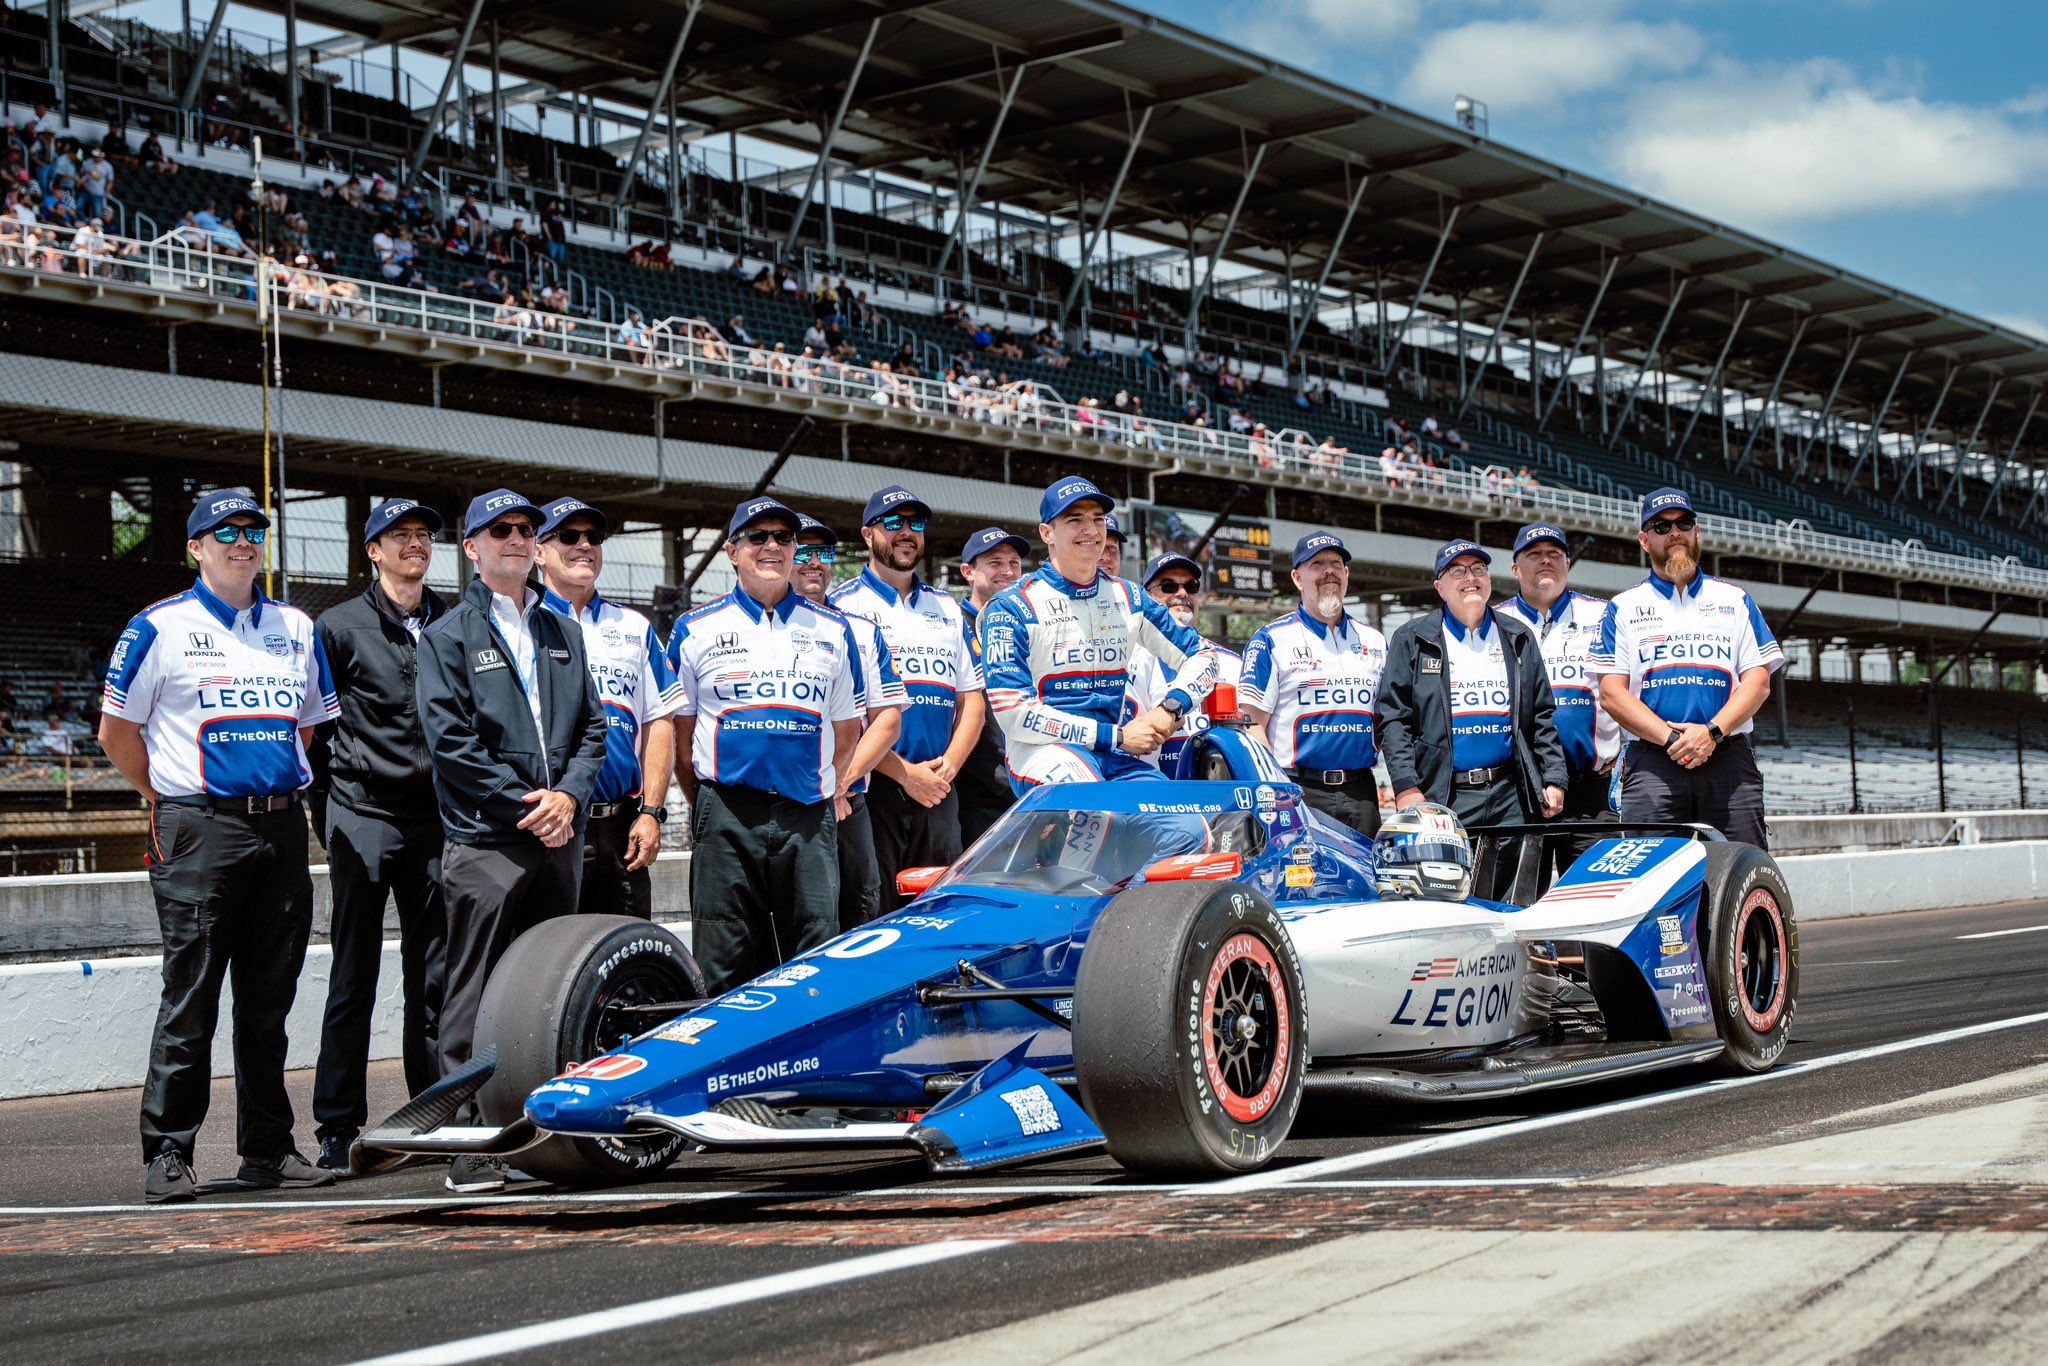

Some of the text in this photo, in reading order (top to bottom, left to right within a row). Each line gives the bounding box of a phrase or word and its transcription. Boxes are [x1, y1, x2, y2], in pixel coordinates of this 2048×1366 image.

[688, 598, 727, 617] Firestone
[803, 599, 841, 619] Firestone
[986, 614, 1019, 626] LEGION
[1044, 615, 1080, 627] HONDA
[1629, 617, 1664, 625] HONDA
[999, 629, 1014, 641] THE
[1078, 637, 1128, 646] AMERICAN
[1665, 633, 1731, 643] AMERICAN
[184, 650, 227, 658] HONDA
[707, 647, 750, 657] HONDA
[898, 646, 958, 660] AMERICAN
[986, 642, 1016, 665] ONE
[1052, 647, 1128, 667] LEGION
[1638, 643, 1731, 664] LEGION
[474, 661, 507, 673] HONDA
[590, 663, 639, 683] ERICAN
[893, 657, 957, 678] EGION
[750, 669, 829, 682] AMERICAN
[1642, 676, 1727, 689] BETHEONE.ORG
[232, 676, 306, 690] AMERICAN
[597, 675, 636, 699] ION
[1457, 680, 1508, 689] AMERIC
[713, 681, 828, 703] LEGION
[1297, 688, 1376, 706] LEGIO
[1450, 690, 1509, 707] EGIO
[197, 688, 306, 711] LEGION
[909, 695, 955, 708] EONE.ORG
[1022, 710, 1089, 745] BE THE ONE
[1302, 723, 1372, 734] BETHEONE.O
[1138, 803, 1222, 813] BETHEONE.ORG
[1257, 801, 1277, 809] INDYCAR
[1423, 836, 1461, 846] LEGION
[1602, 843, 1661, 859] BE
[1587, 862, 1638, 876] ONE
[1429, 882, 1457, 890] HONDA
[1658, 918, 1681, 932] TRENCH
[1660, 930, 1682, 943] SHORING
[598, 937, 673, 981] Firestone
[1454, 951, 1518, 978] AMERICAN
[1655, 967, 1678, 978] HPD
[1389, 981, 1514, 1028] LEGION
[1670, 1004, 1707, 1018] Firestone
[1203, 938, 1252, 1102] SAVE A VETERAN
[1187, 978, 1214, 1115] Firestone
[1249, 969, 1289, 1116] BETHEONE.ORG
[707, 1057, 820, 1093] BETHEONE.ORG
[634, 1136, 682, 1169] HAWK
